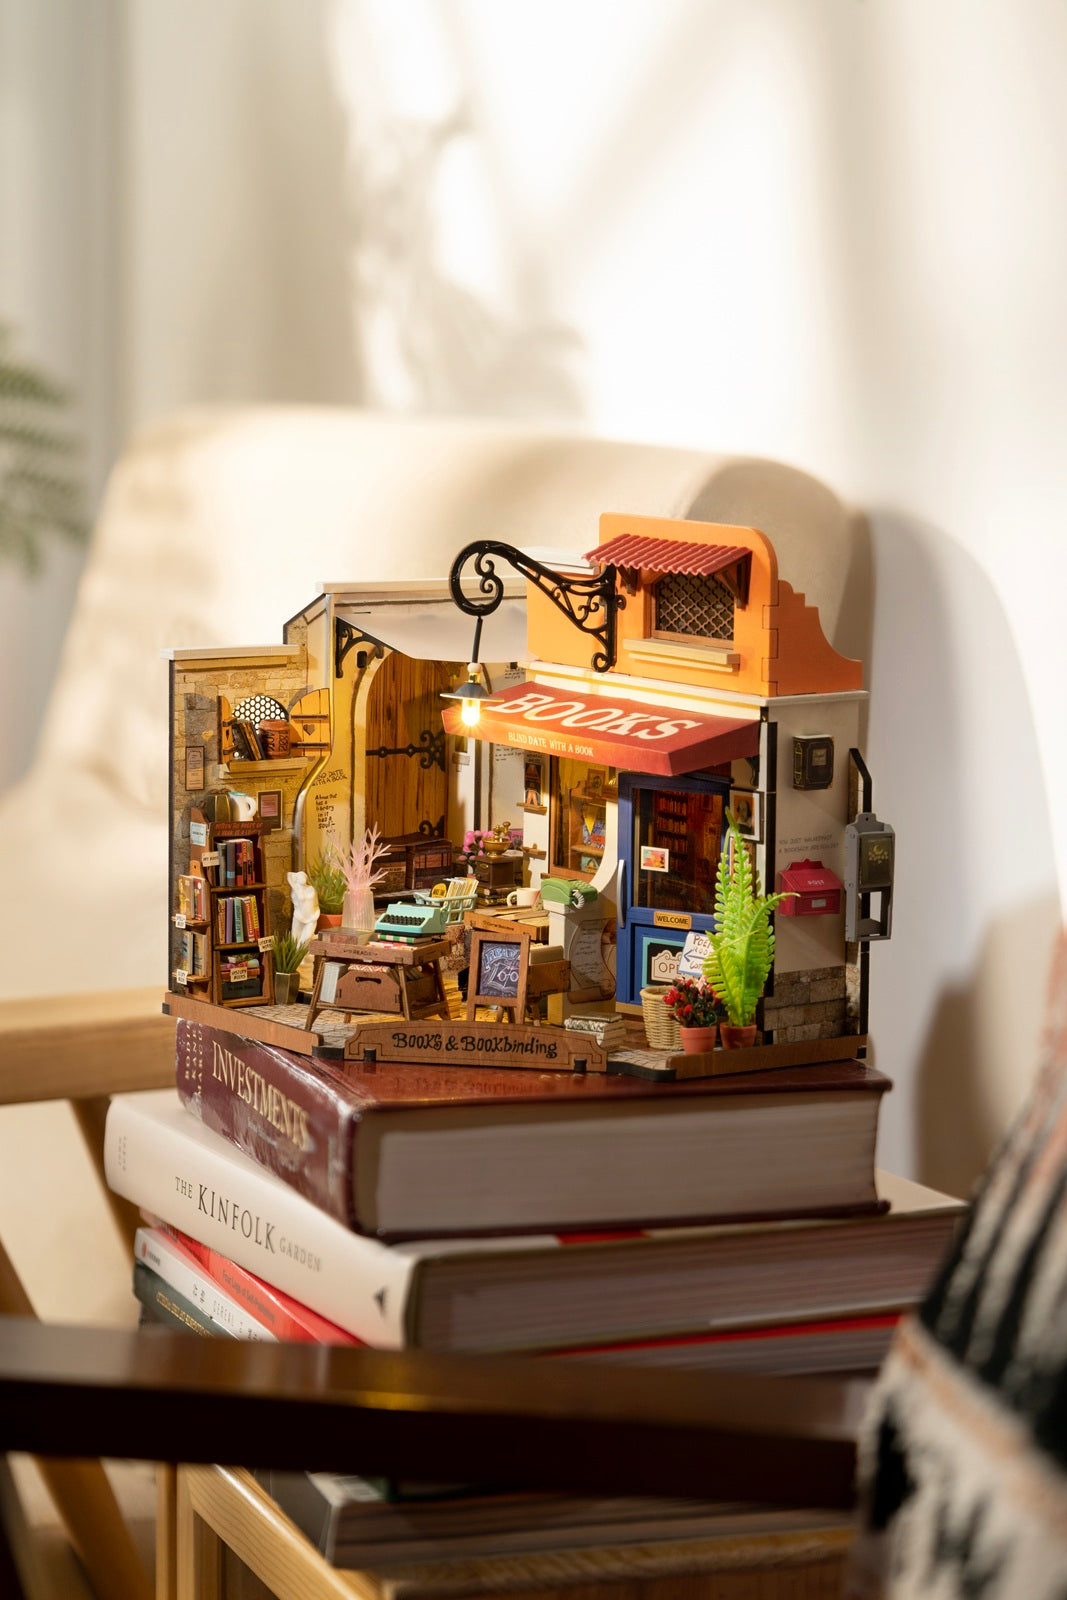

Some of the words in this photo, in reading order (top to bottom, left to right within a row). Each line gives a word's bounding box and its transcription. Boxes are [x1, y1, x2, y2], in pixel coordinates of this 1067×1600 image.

[486, 692, 703, 740] BOOKS
[508, 732, 528, 744] BLIND
[528, 735, 547, 748] DATE
[549, 738, 567, 751] WITH
[568, 743, 574, 753] A
[575, 744, 594, 757] BOOK
[656, 915, 689, 924] WELCOME
[445, 1035, 458, 1051] &
[211, 1039, 309, 1151] INVESTMENTS
[175, 1176, 193, 1200] THE
[198, 1184, 276, 1254] KINFOLK
[279, 1236, 322, 1272] GARDEN
